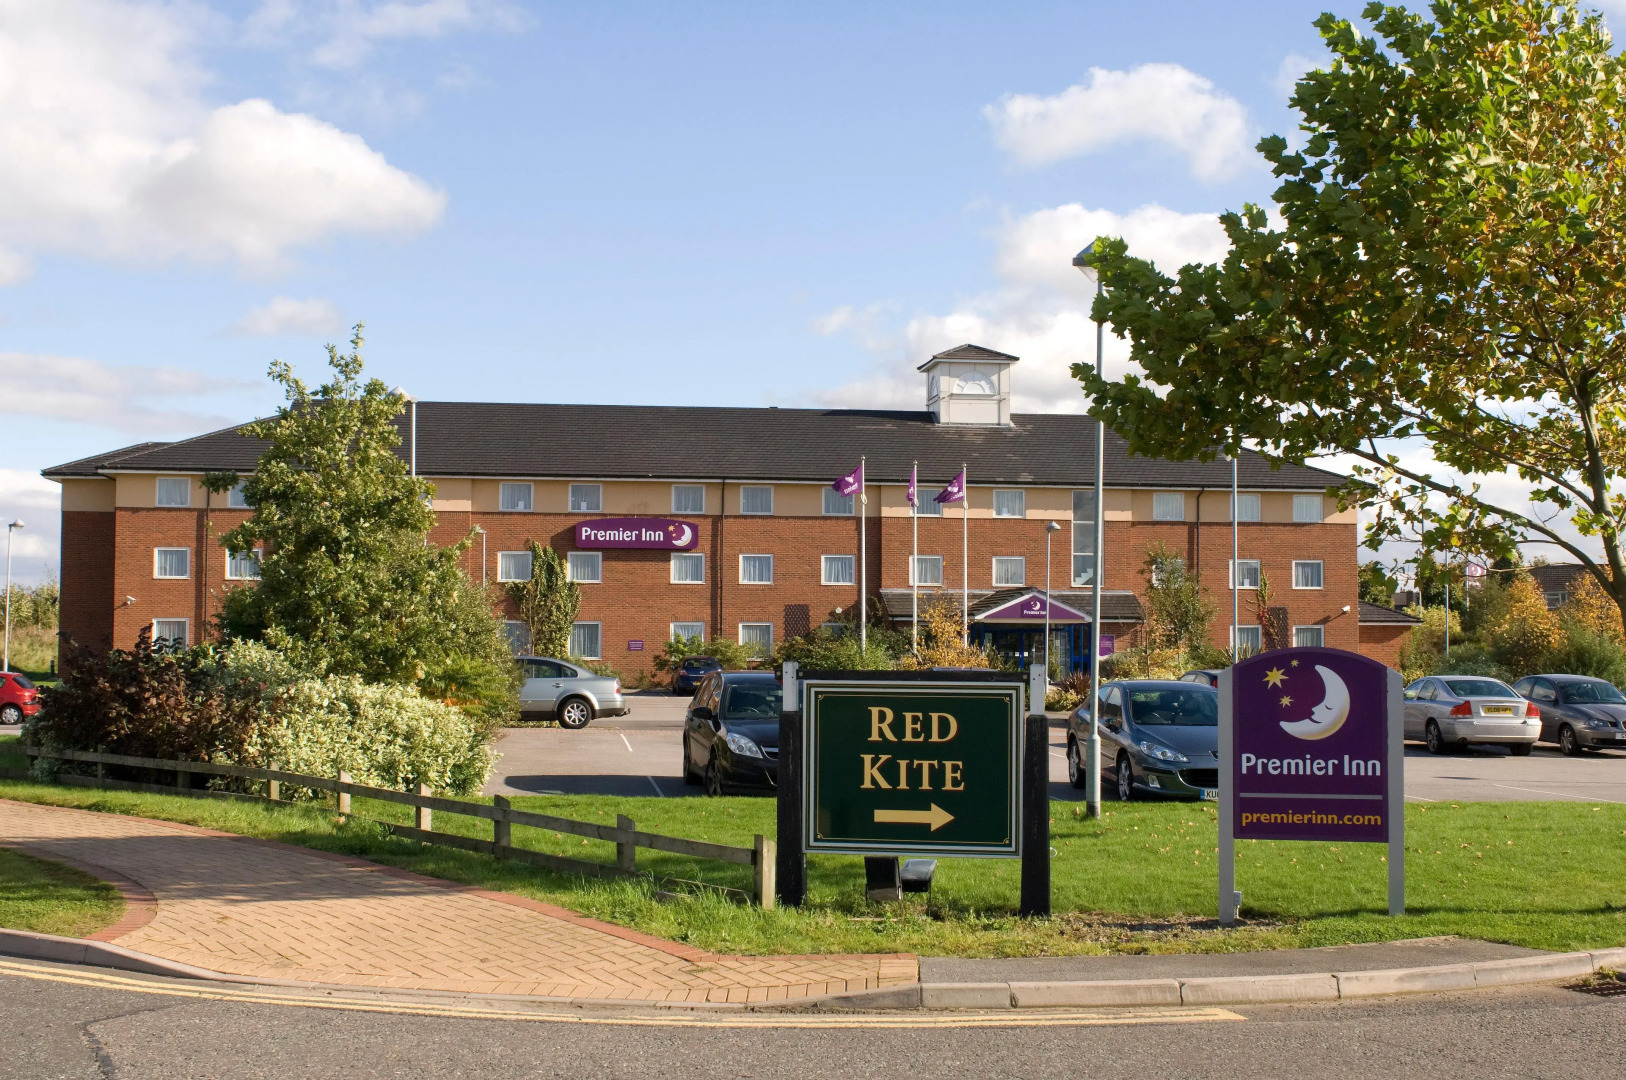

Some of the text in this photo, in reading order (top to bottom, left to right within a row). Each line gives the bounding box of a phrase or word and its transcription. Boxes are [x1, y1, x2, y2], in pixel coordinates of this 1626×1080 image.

[581, 527, 664, 541] Premier Inn
[1241, 753, 1381, 776] Premier Inn
[1241, 809, 1381, 826] premierinn.com
